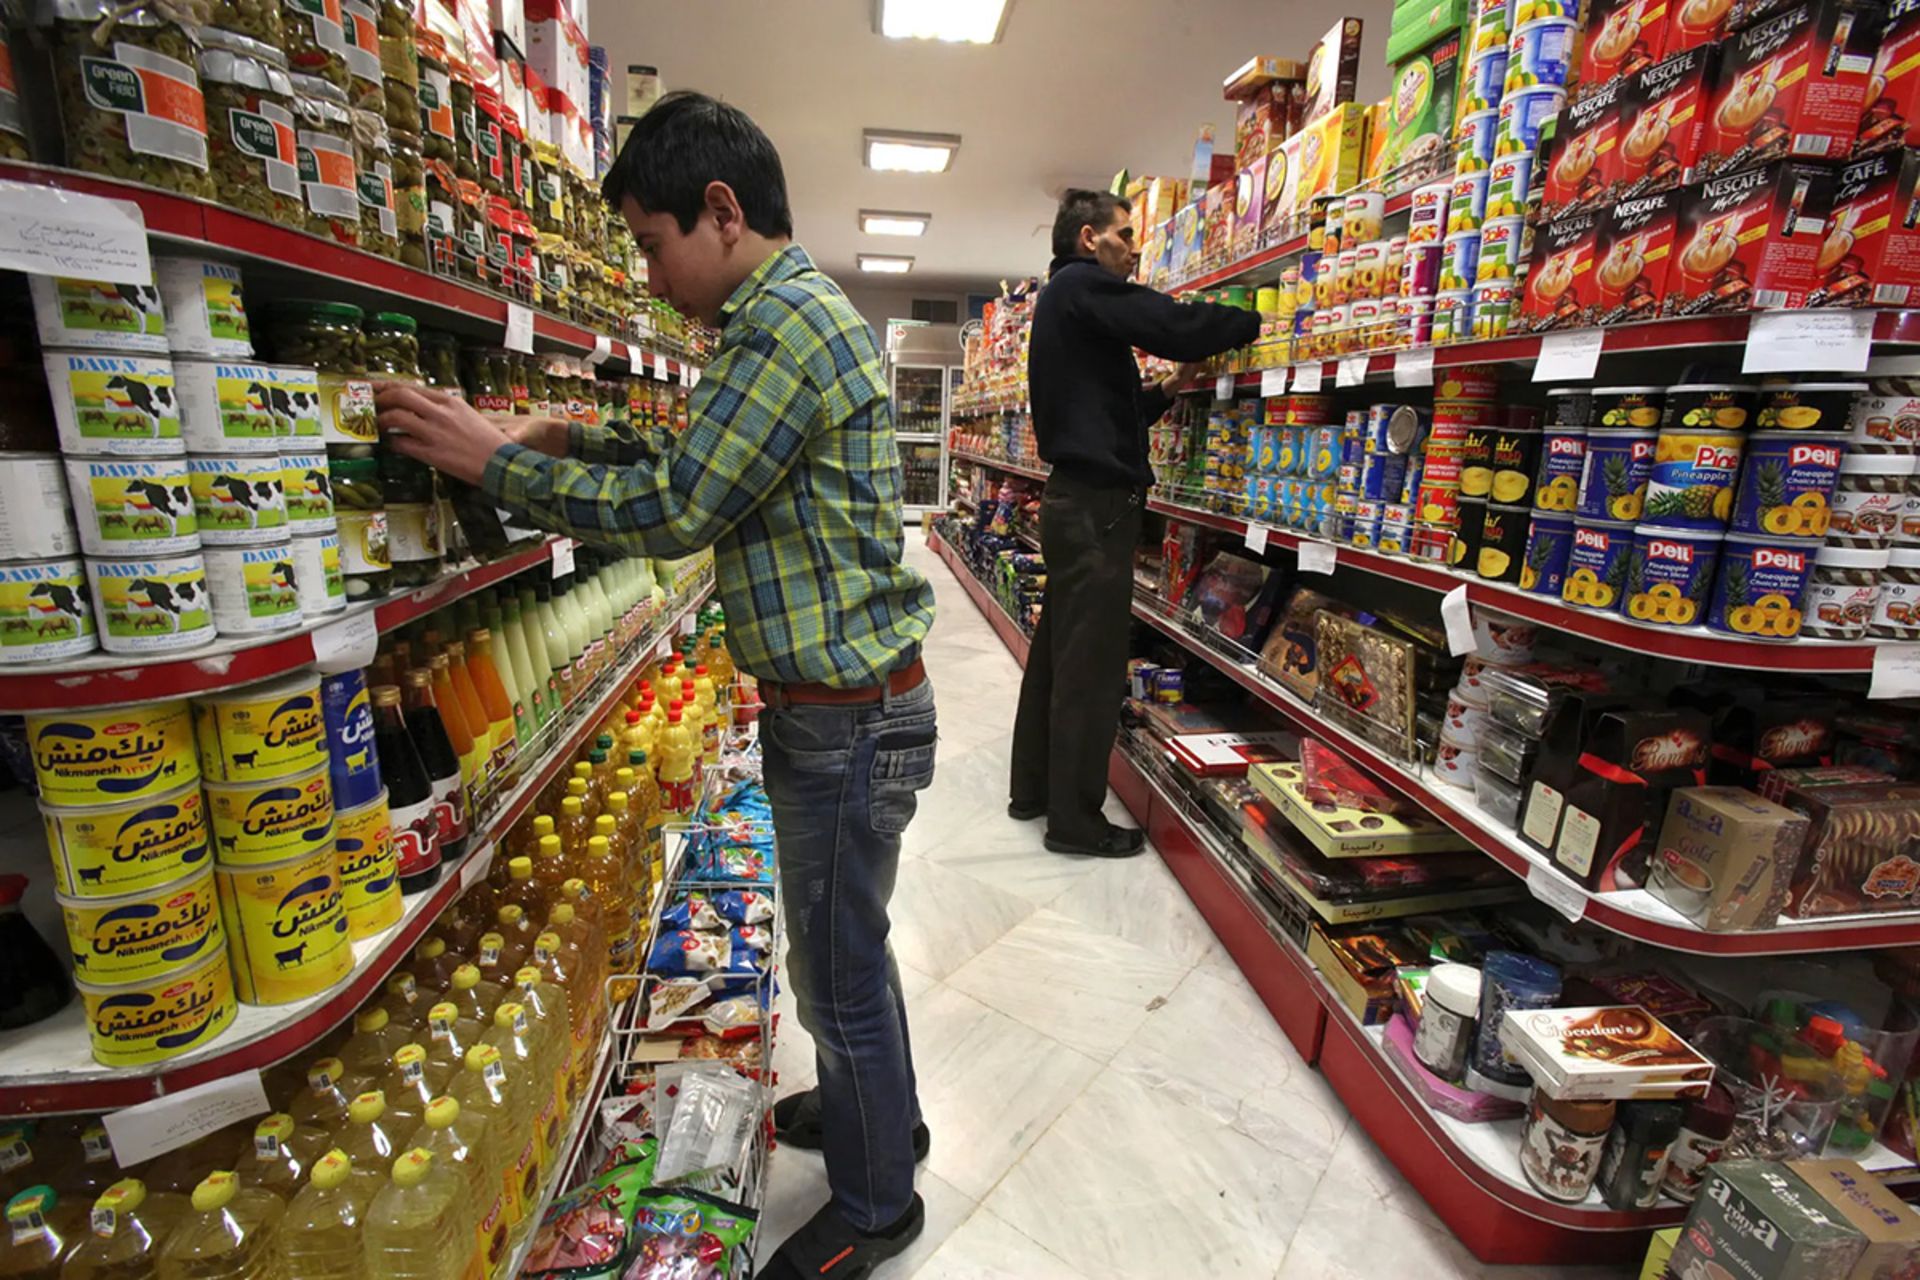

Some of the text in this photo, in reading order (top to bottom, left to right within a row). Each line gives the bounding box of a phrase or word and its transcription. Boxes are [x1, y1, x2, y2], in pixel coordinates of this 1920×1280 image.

[1739, 5, 1808, 50] NESCAFÉ
[92, 64, 134, 84] Green
[1640, 52, 1695, 88] NESCAFÉ
[1569, 88, 1617, 119] NESCAFÉ
[240, 117, 272, 134] Green
[1842, 157, 1887, 184] CAFÉ
[1702, 167, 1768, 199] NESCAFÉ
[1613, 195, 1667, 219] NESCAFÉ
[1549, 215, 1594, 236] NESCAFÉ
[1481, 288, 1513, 300] Dole
[68, 356, 138, 373] DAWN
[1551, 439, 1584, 454] Deli
[1634, 443, 1655, 458] De
[1793, 446, 1837, 466] Deli
[1695, 446, 1737, 468] Pine
[89, 463, 157, 478] DAWN
[1671, 468, 1727, 481] Pineapple
[1792, 470, 1834, 478] Pineapple
[1576, 530, 1605, 549] Deli
[1650, 542, 1689, 562] Deli
[1755, 551, 1801, 570] Deli
[97, 564, 158, 577] DAWN
[1753, 572, 1799, 581] Pineapple
[54, 765, 122, 778] Nikmanesh
[344, 868, 381, 887] manesh
[116, 934, 184, 958] Nikmanesh
[115, 1022, 180, 1042] Nikmanesh
[1527, 1014, 1635, 1038] Chocodan's
[1707, 1178, 1778, 1251] aroma
